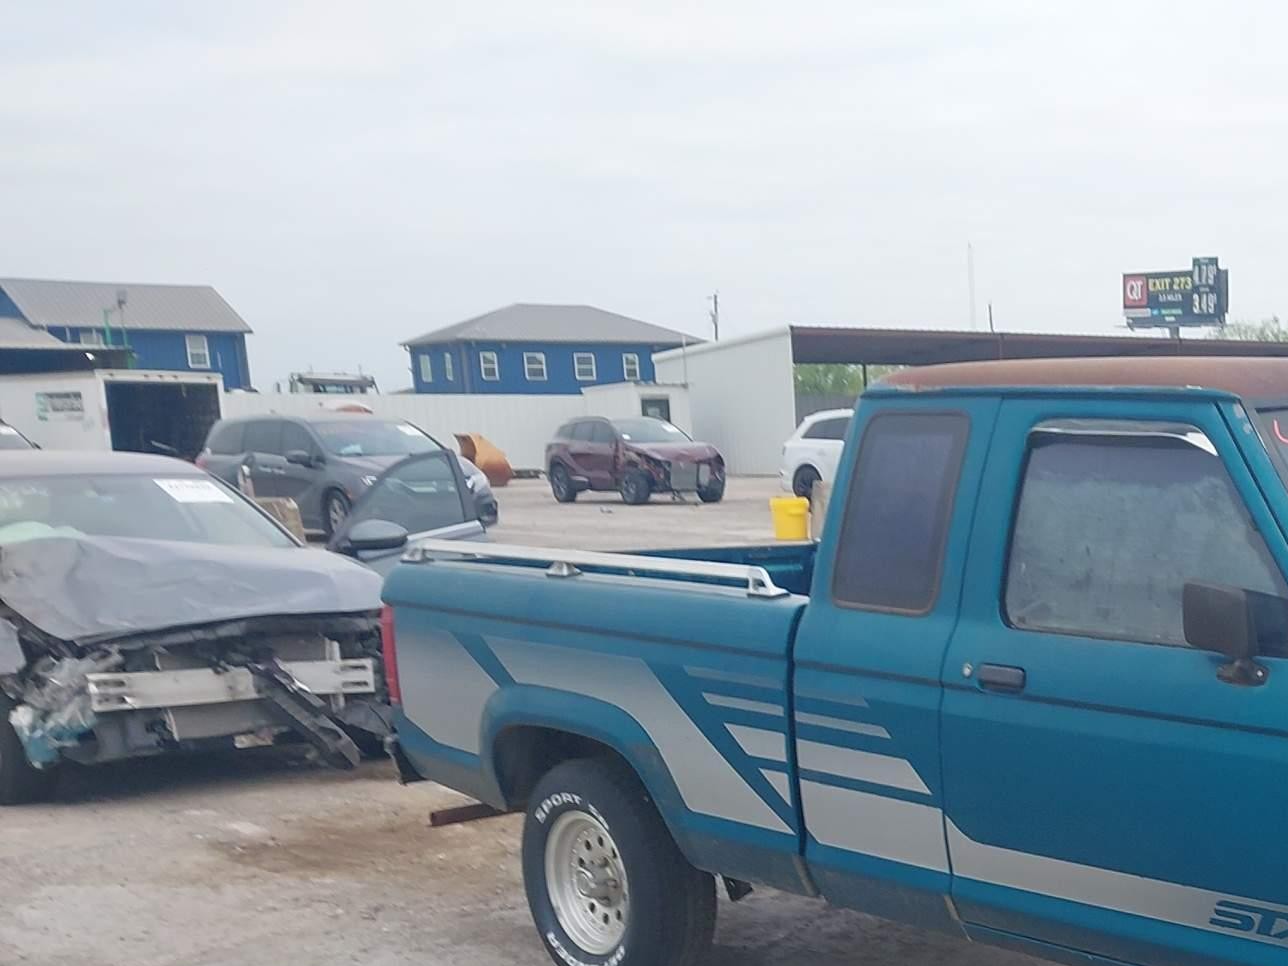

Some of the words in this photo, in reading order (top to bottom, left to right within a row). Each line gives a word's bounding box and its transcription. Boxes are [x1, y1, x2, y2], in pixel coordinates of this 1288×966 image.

[1126, 279, 1144, 300] QT
[1148, 278, 1171, 291] EXIT
[1173, 276, 1193, 290] 273
[534, 792, 583, 825] SPORT
